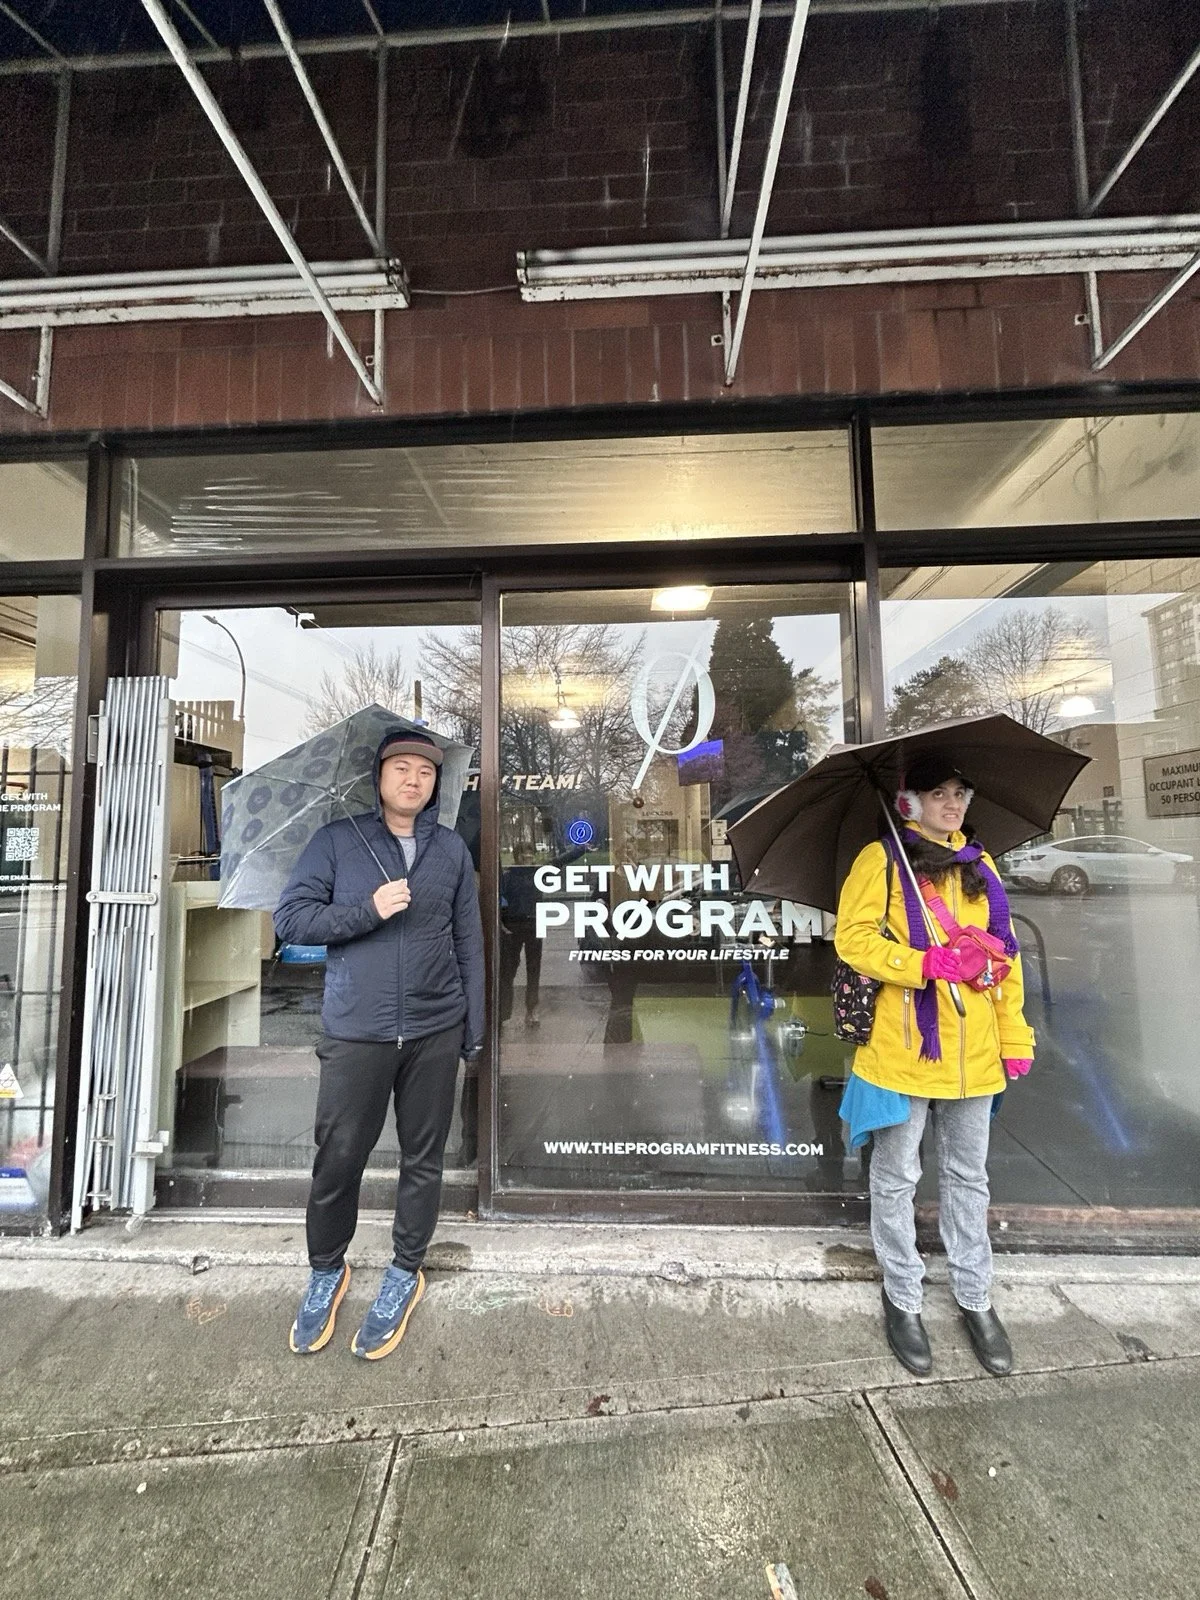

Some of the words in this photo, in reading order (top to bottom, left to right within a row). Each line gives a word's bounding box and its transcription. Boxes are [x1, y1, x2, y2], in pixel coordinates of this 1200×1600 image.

[1162, 763, 1200, 776] MAXIMU
[513, 774, 581, 791] TEAM!
[1149, 777, 1194, 792] OCCUPANT
[1161, 795, 1171, 804] 50
[0, 804, 9, 812] E
[533, 865, 615, 893] GET
[623, 864, 729, 892] WITH
[535, 898, 823, 941] PRØGRAM
[568, 949, 631, 962] FITNESS
[633, 949, 667, 961] FOR
[667, 949, 708, 961] YOUR
[709, 949, 790, 961] LIFESTYLE
[543, 1141, 824, 1156] WWW.THEPROGRAMFITNESS.COM
